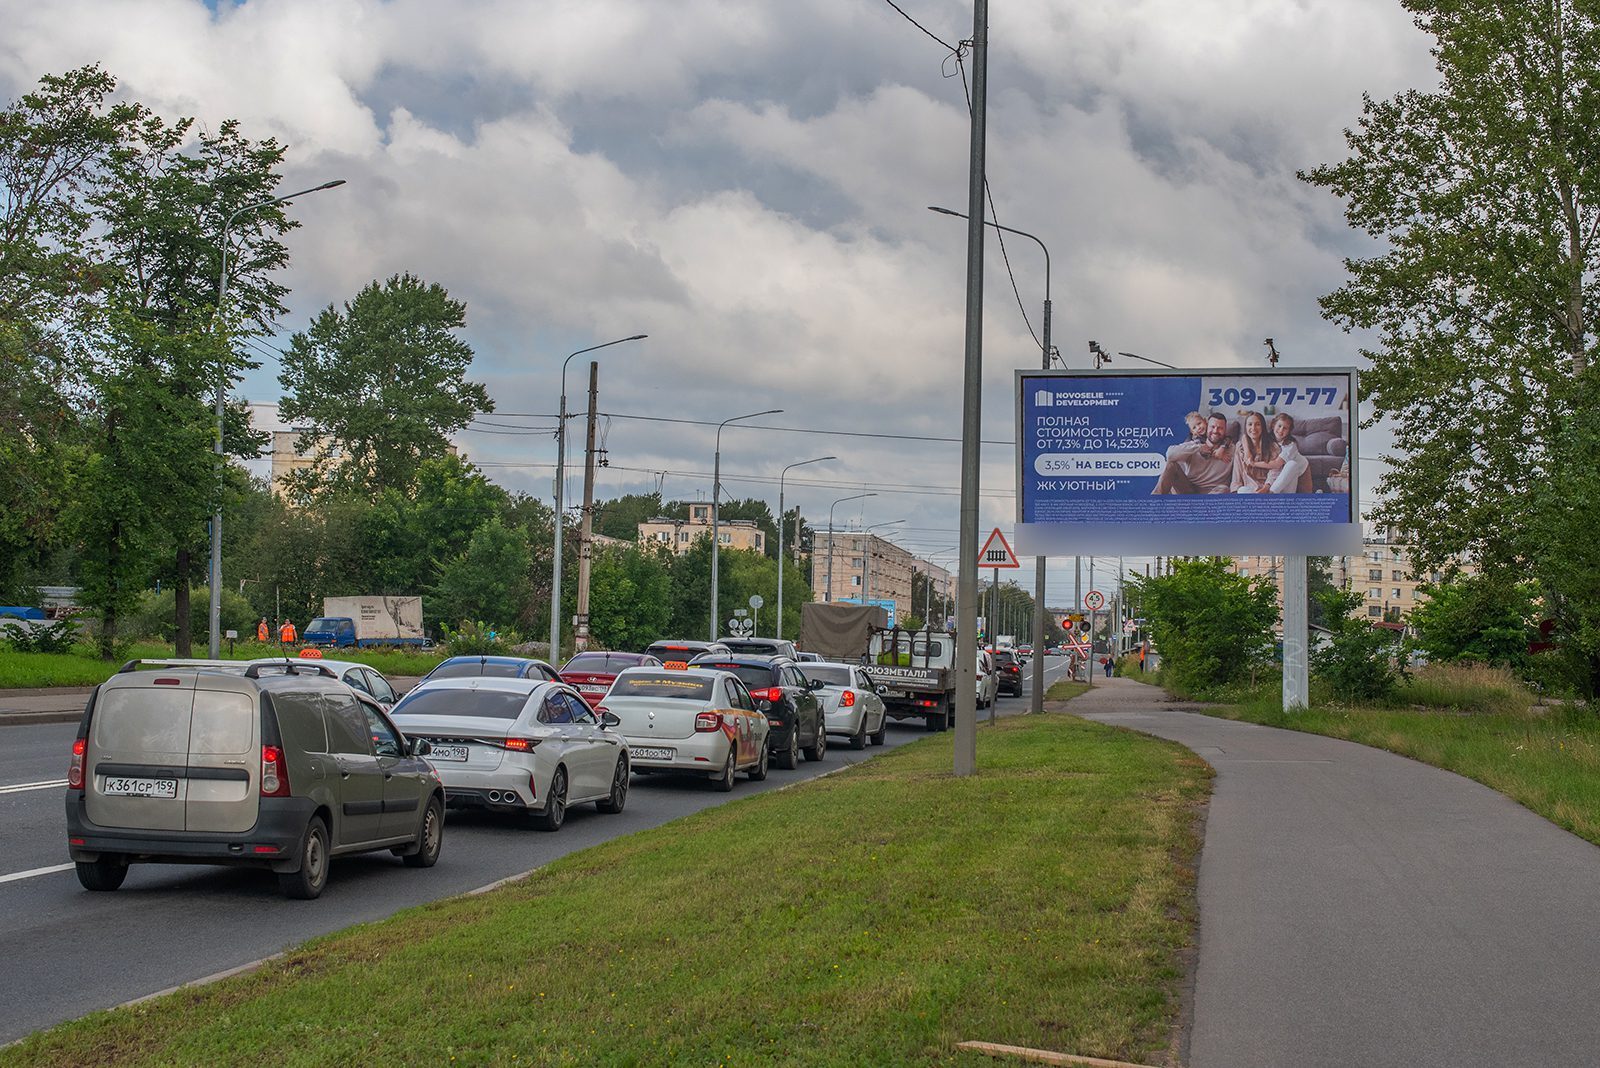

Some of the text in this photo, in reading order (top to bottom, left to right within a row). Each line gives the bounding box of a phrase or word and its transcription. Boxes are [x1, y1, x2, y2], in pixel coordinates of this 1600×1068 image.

[1208, 387, 1338, 406] 309-77-77
[1037, 416, 1090, 426] ПОЛНАЯ
[1036, 427, 1174, 438] СТОИМОСТЬ КРЕДИТА
[1036, 439, 1149, 450] ОТ 7,3% ДО 14,523%
[1076, 461, 1092, 469] НА
[1095, 461, 1124, 469] ВЕСЬ
[1126, 461, 1161, 469] СРОК!
[1037, 481, 1057, 490] ЖК
[430, 747, 466, 757] 4МО 198
[108, 779, 173, 793] К361СР 159
